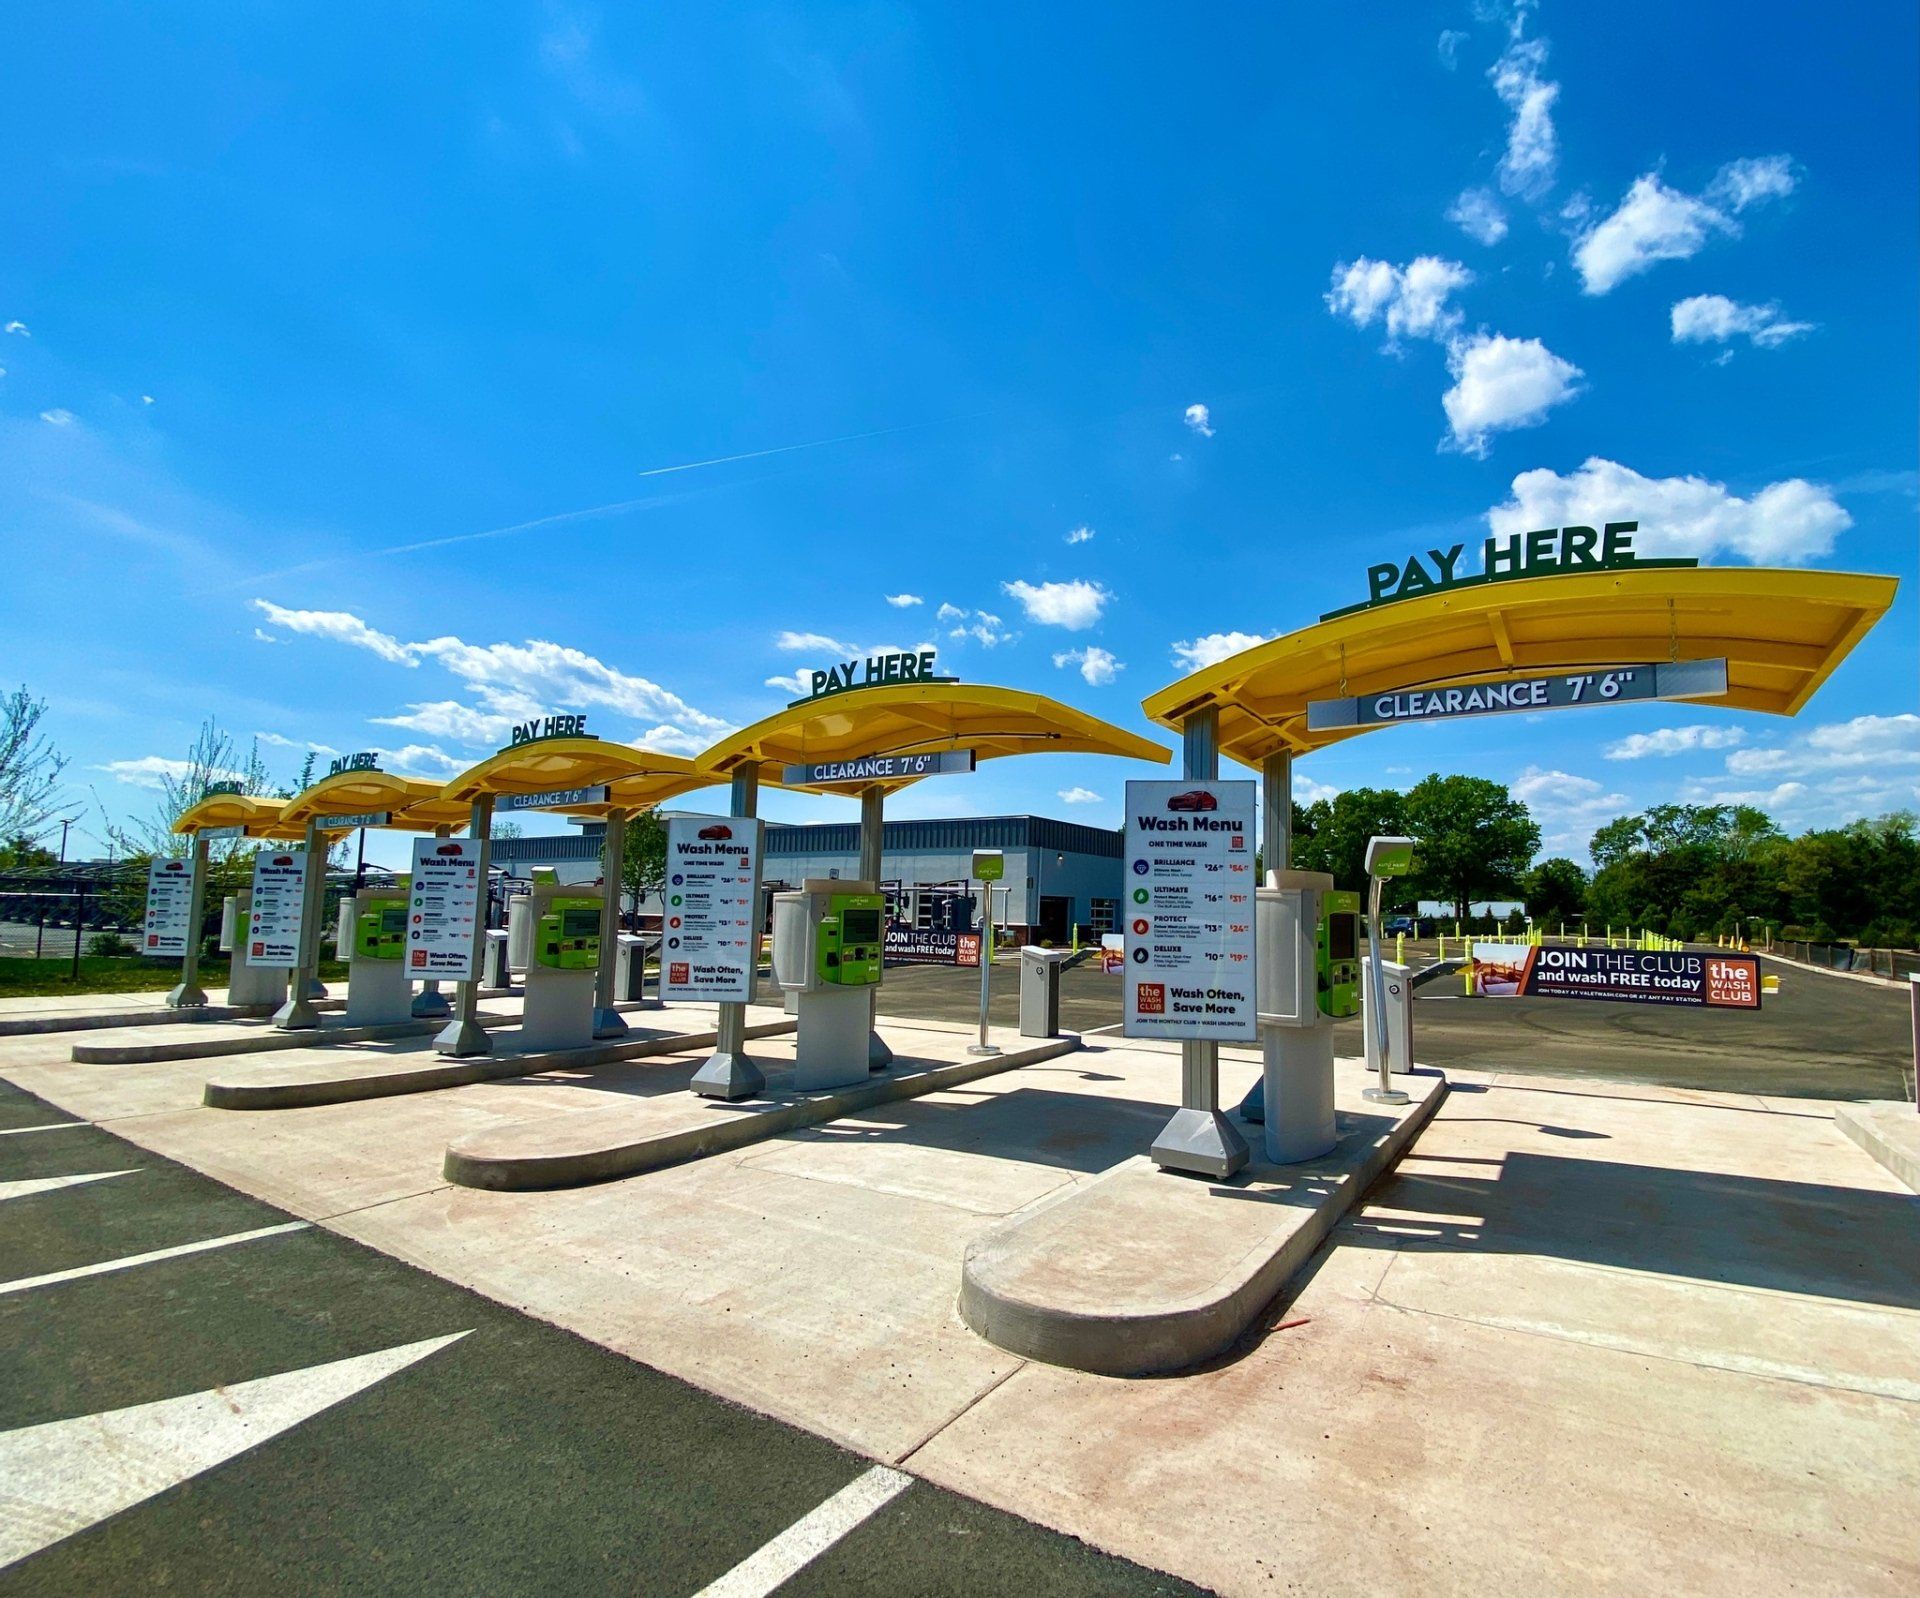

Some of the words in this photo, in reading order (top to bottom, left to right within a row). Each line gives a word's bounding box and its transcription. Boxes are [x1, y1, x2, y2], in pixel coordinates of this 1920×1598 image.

[1367, 544, 1464, 600] PAY
[1485, 521, 1639, 573] HERE
[812, 661, 858, 696] PAY
[866, 652, 935, 682] HERE
[1374, 680, 1548, 719] CLEARANCE
[512, 719, 540, 745] PAY
[544, 715, 586, 737] HERE
[330, 755, 350, 775] PAY
[351, 752, 378, 768] HERE
[814, 759, 893, 780] CLEARANCE
[514, 792, 560, 807] CLEARANCE
[1138, 816, 1188, 831] Wash
[1193, 817, 1243, 831] Menu
[677, 844, 711, 854] Wash
[715, 844, 749, 854] Menu
[420, 858, 446, 866] Wash
[449, 858, 474, 866] Menu
[885, 932, 908, 942] JOIN
[910, 932, 928, 944] THE
[930, 934, 956, 945] CLUB
[960, 937, 976, 948] the
[885, 944, 897, 952] and
[898, 945, 915, 953] wash
[917, 945, 934, 953] FREE
[935, 946, 955, 956] today
[1537, 951, 1587, 968] JOIN
[1592, 953, 1635, 971] THE
[1640, 955, 1701, 974] CLUB
[717, 966, 743, 974] Often,
[1710, 962, 1749, 980] the
[1537, 970, 1564, 981] and
[1568, 972, 1607, 984] wash
[1610, 972, 1650, 987] FREE
[1653, 975, 1701, 991] today
[1710, 980, 1751, 990] WASH
[1140, 985, 1160, 996] the
[1170, 988, 1203, 999] Wash
[1207, 989, 1245, 1001] Often,
[1711, 990, 1752, 1001] CLUB
[1173, 1002, 1203, 1012] Save
[1205, 1003, 1235, 1013] More
